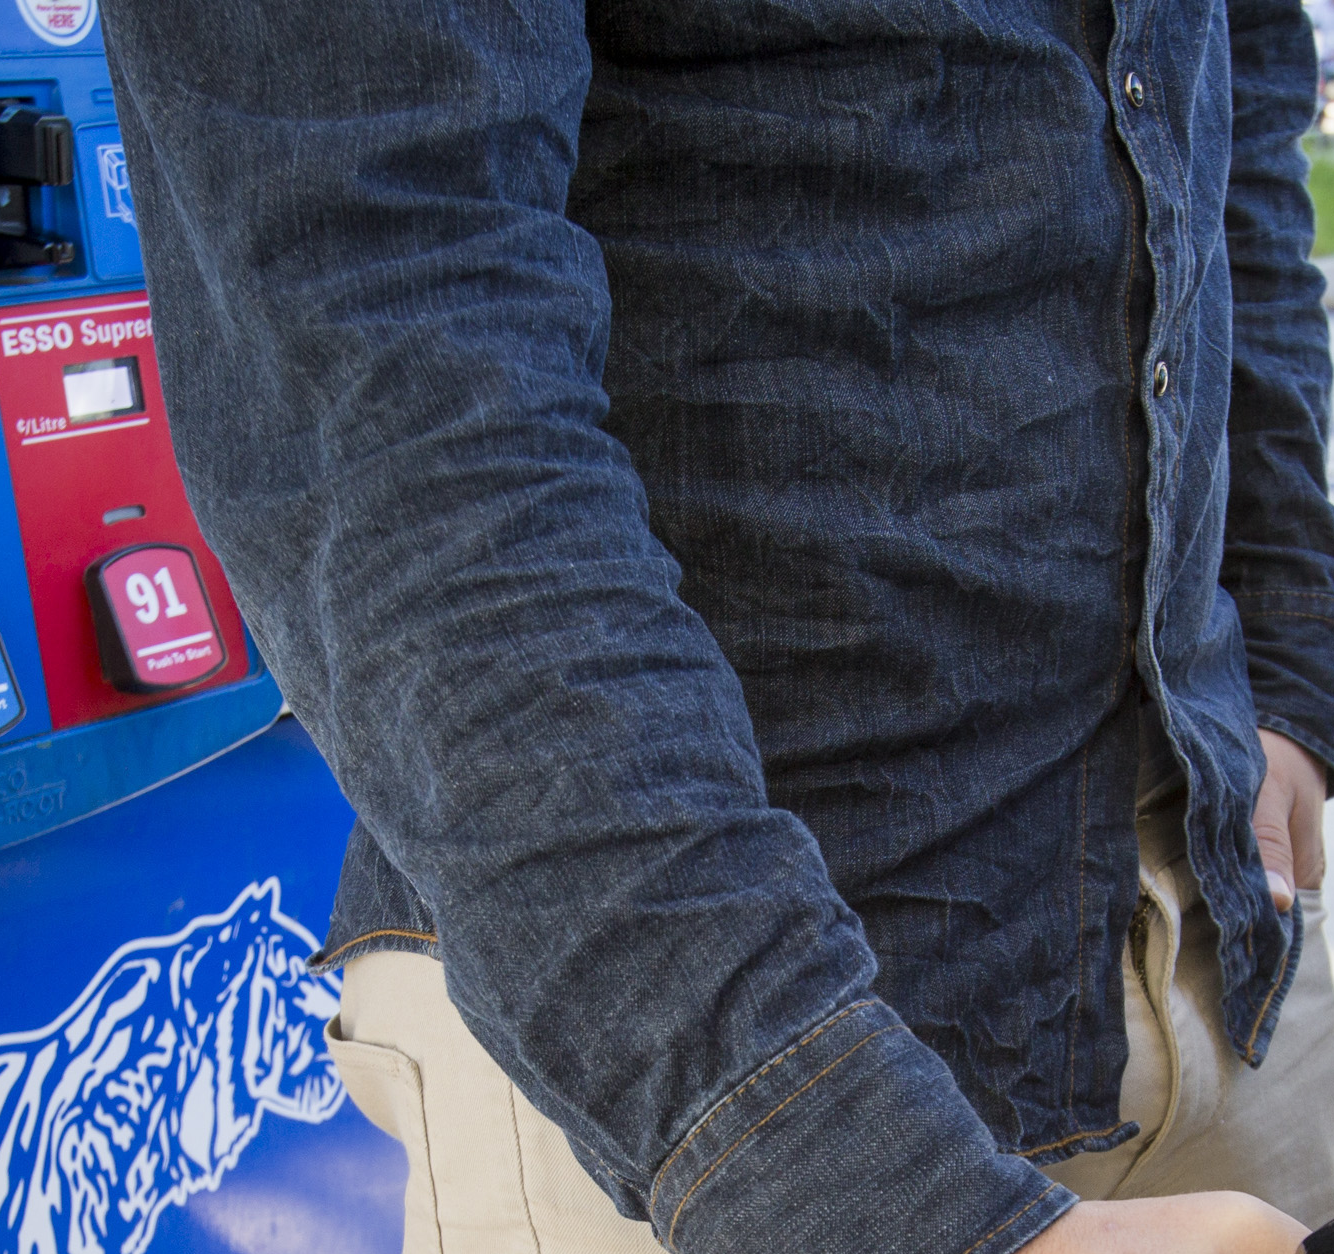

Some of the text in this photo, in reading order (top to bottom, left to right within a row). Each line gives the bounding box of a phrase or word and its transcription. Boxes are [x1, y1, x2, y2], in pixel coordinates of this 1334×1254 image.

[48, 13, 75, 28] HERE
[0, 322, 74, 357] ESSO
[126, 567, 188, 624] 91
[185, 645, 212, 661] Start
